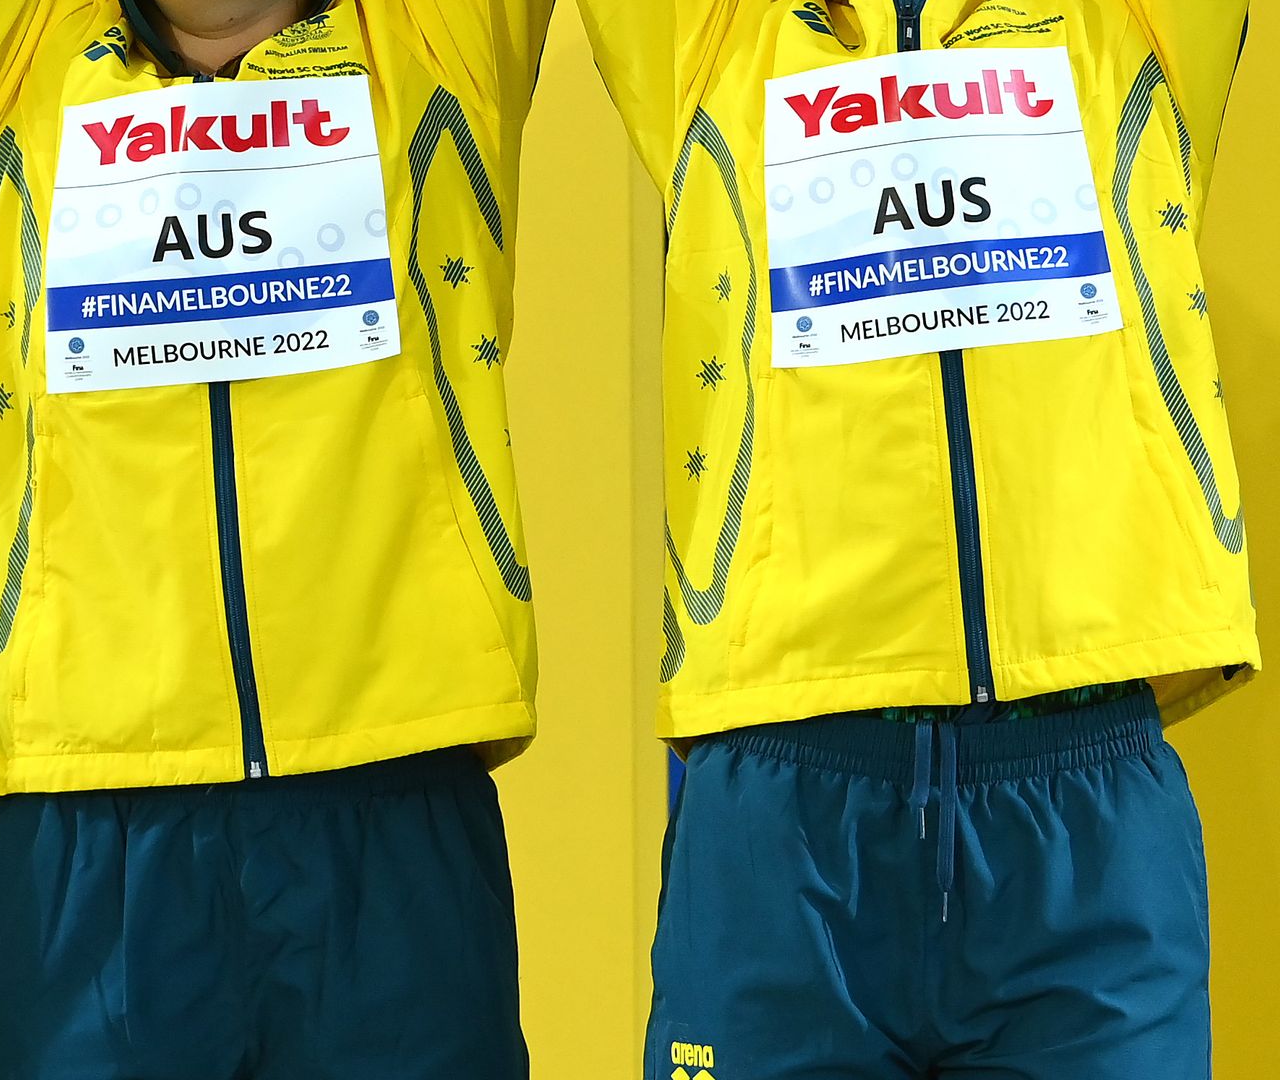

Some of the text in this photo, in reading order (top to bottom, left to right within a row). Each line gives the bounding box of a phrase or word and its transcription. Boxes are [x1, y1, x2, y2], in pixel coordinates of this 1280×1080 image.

[264, 45, 349, 59] AUSTRALIAN SWIM TEAM
[942, 33, 965, 50] 2022
[964, 25, 991, 37] World
[267, 67, 296, 76] World
[296, 66, 311, 74] SC
[784, 69, 1055, 139] Yakult
[82, 99, 351, 166] Yakult
[872, 176, 992, 235] AUS
[152, 210, 273, 263] AUS
[808, 245, 1070, 297] #FINAMELBOURNE22
[81, 273, 352, 319] #FINAMELBOURNE22
[840, 304, 989, 343] MELBOURNE
[996, 300, 1050, 323] 2022
[113, 336, 267, 368] MELBOURNE
[272, 329, 330, 354] 2022
[671, 1041, 714, 1068] arena
